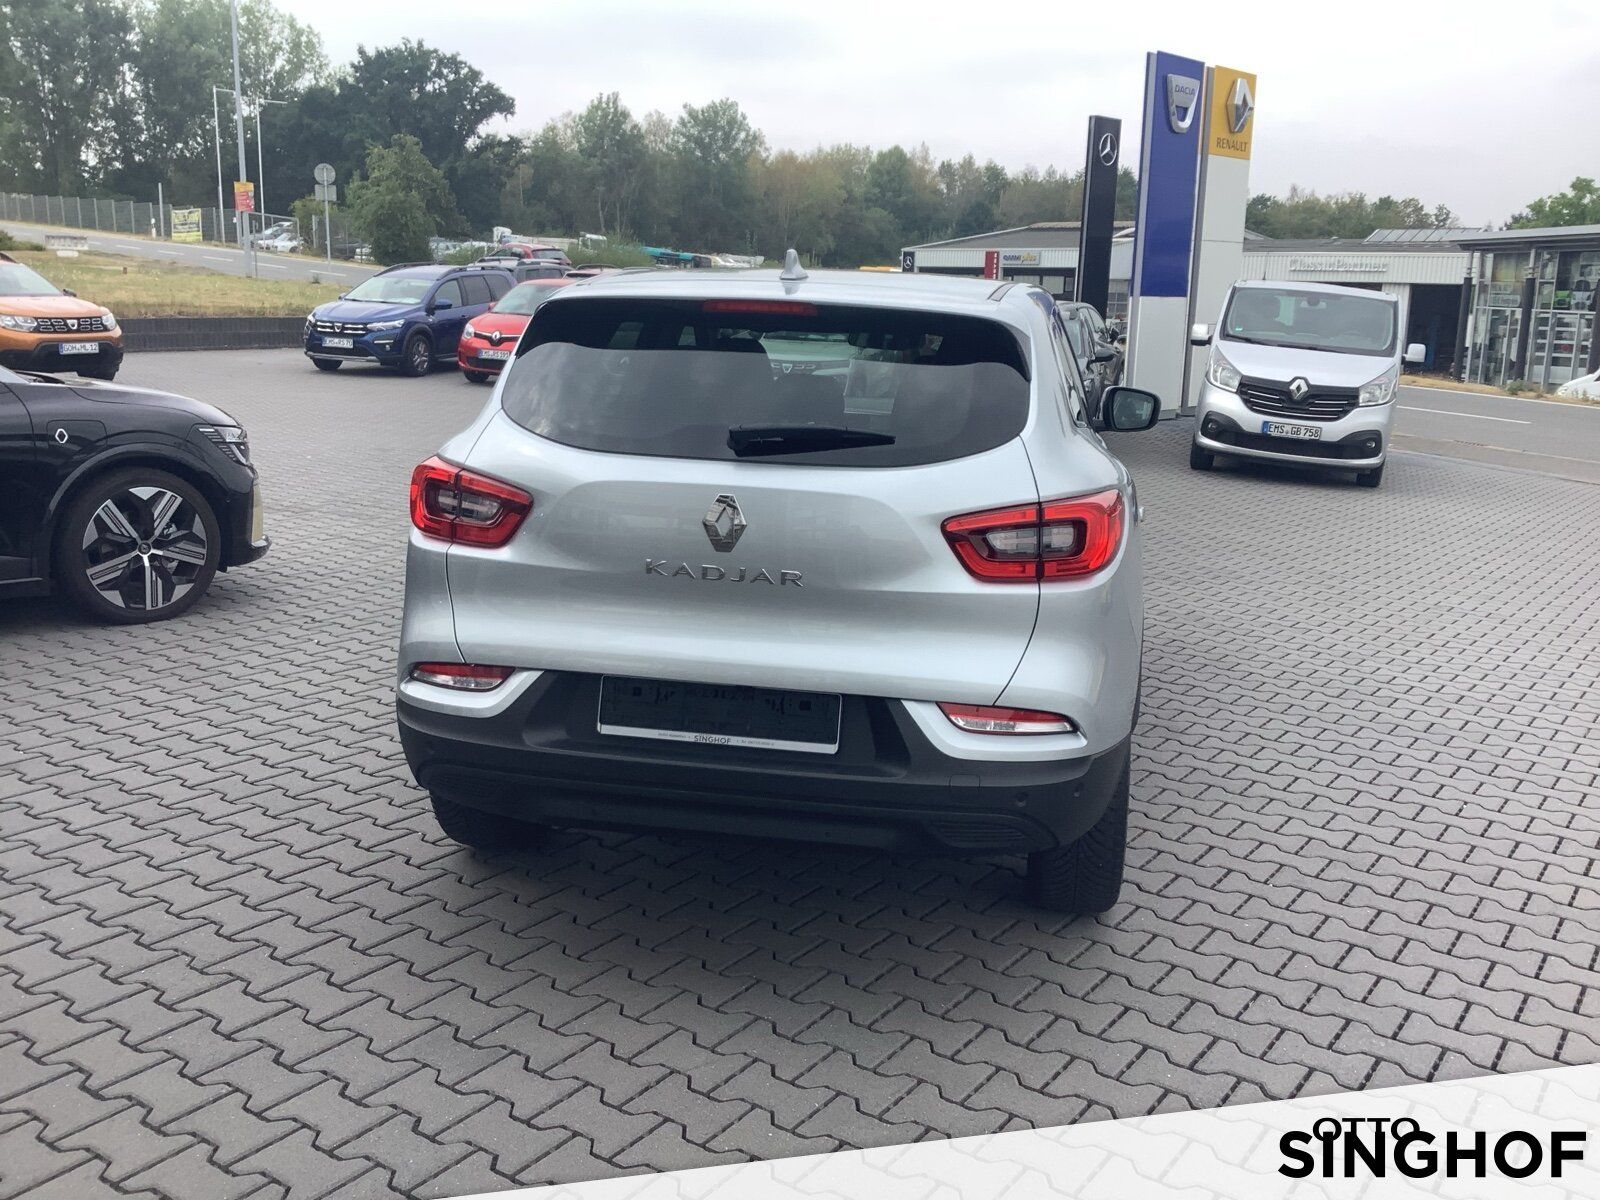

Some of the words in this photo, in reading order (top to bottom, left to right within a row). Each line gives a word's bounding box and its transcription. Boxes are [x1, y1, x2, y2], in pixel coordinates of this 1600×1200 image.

[1174, 84, 1196, 96] DACIA
[1215, 136, 1249, 153] RENAULT
[1268, 423, 1285, 435] EMS
[1290, 426, 1302, 436] GB
[1303, 427, 1320, 438] 758
[645, 558, 804, 587] KADJAR
[693, 734, 732, 745] SINGHOF
